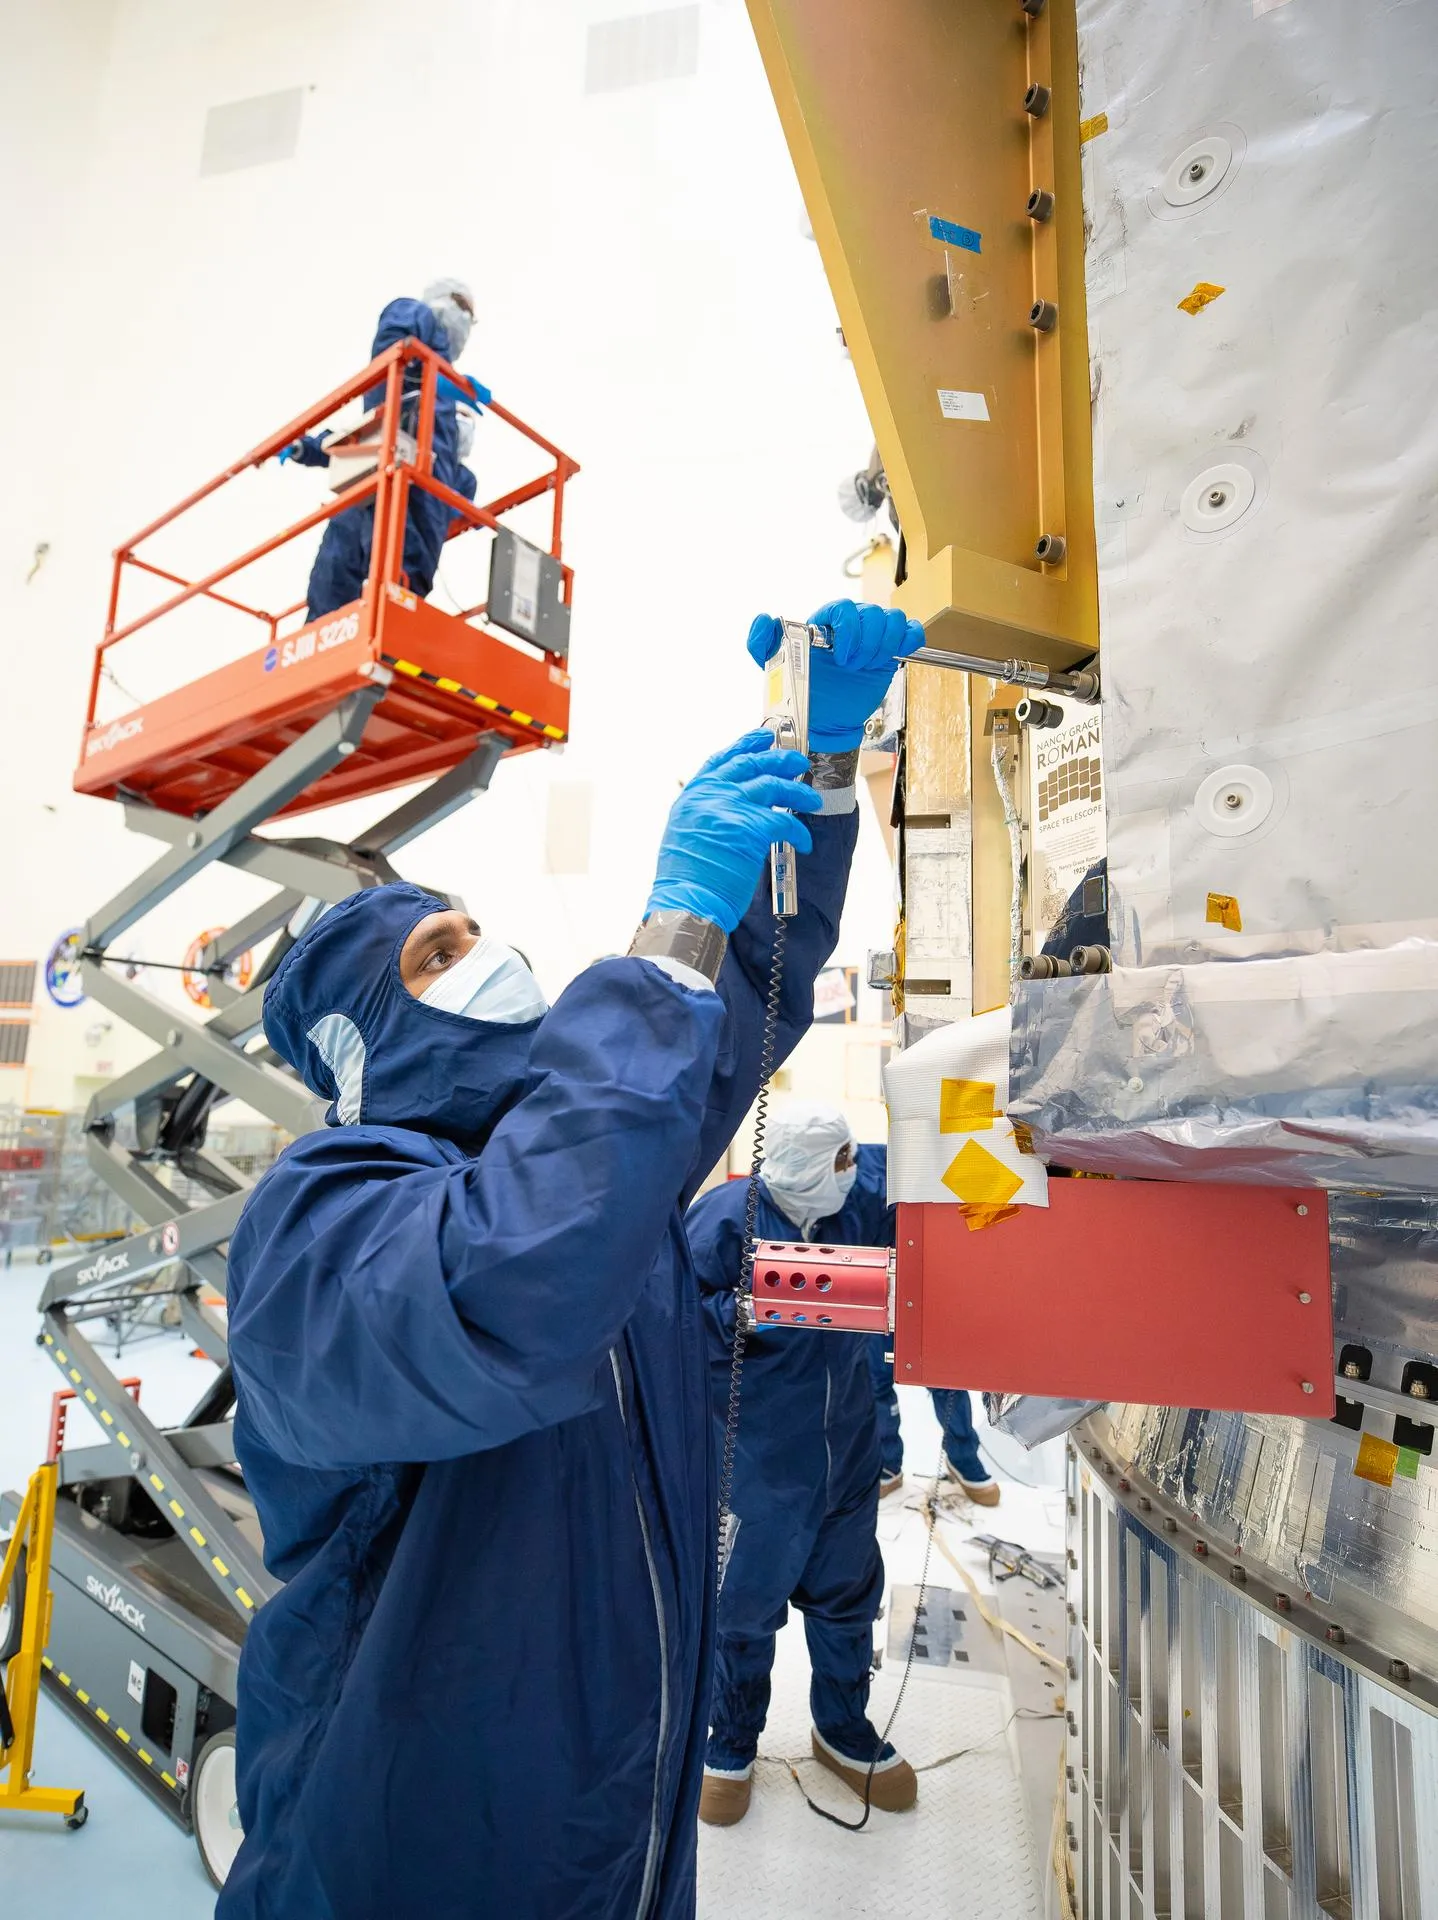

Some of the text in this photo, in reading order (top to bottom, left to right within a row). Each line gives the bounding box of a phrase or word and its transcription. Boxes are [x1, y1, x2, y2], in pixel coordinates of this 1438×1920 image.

[1037, 716, 1099, 753] NANCY GRACE
[1037, 727, 1100, 770] ROMAN
[1039, 804, 1102, 833] SPACE TELESCOPE
[77, 1252, 130, 1285] SKYJACK
[86, 1575, 146, 1632] SKYJACK
